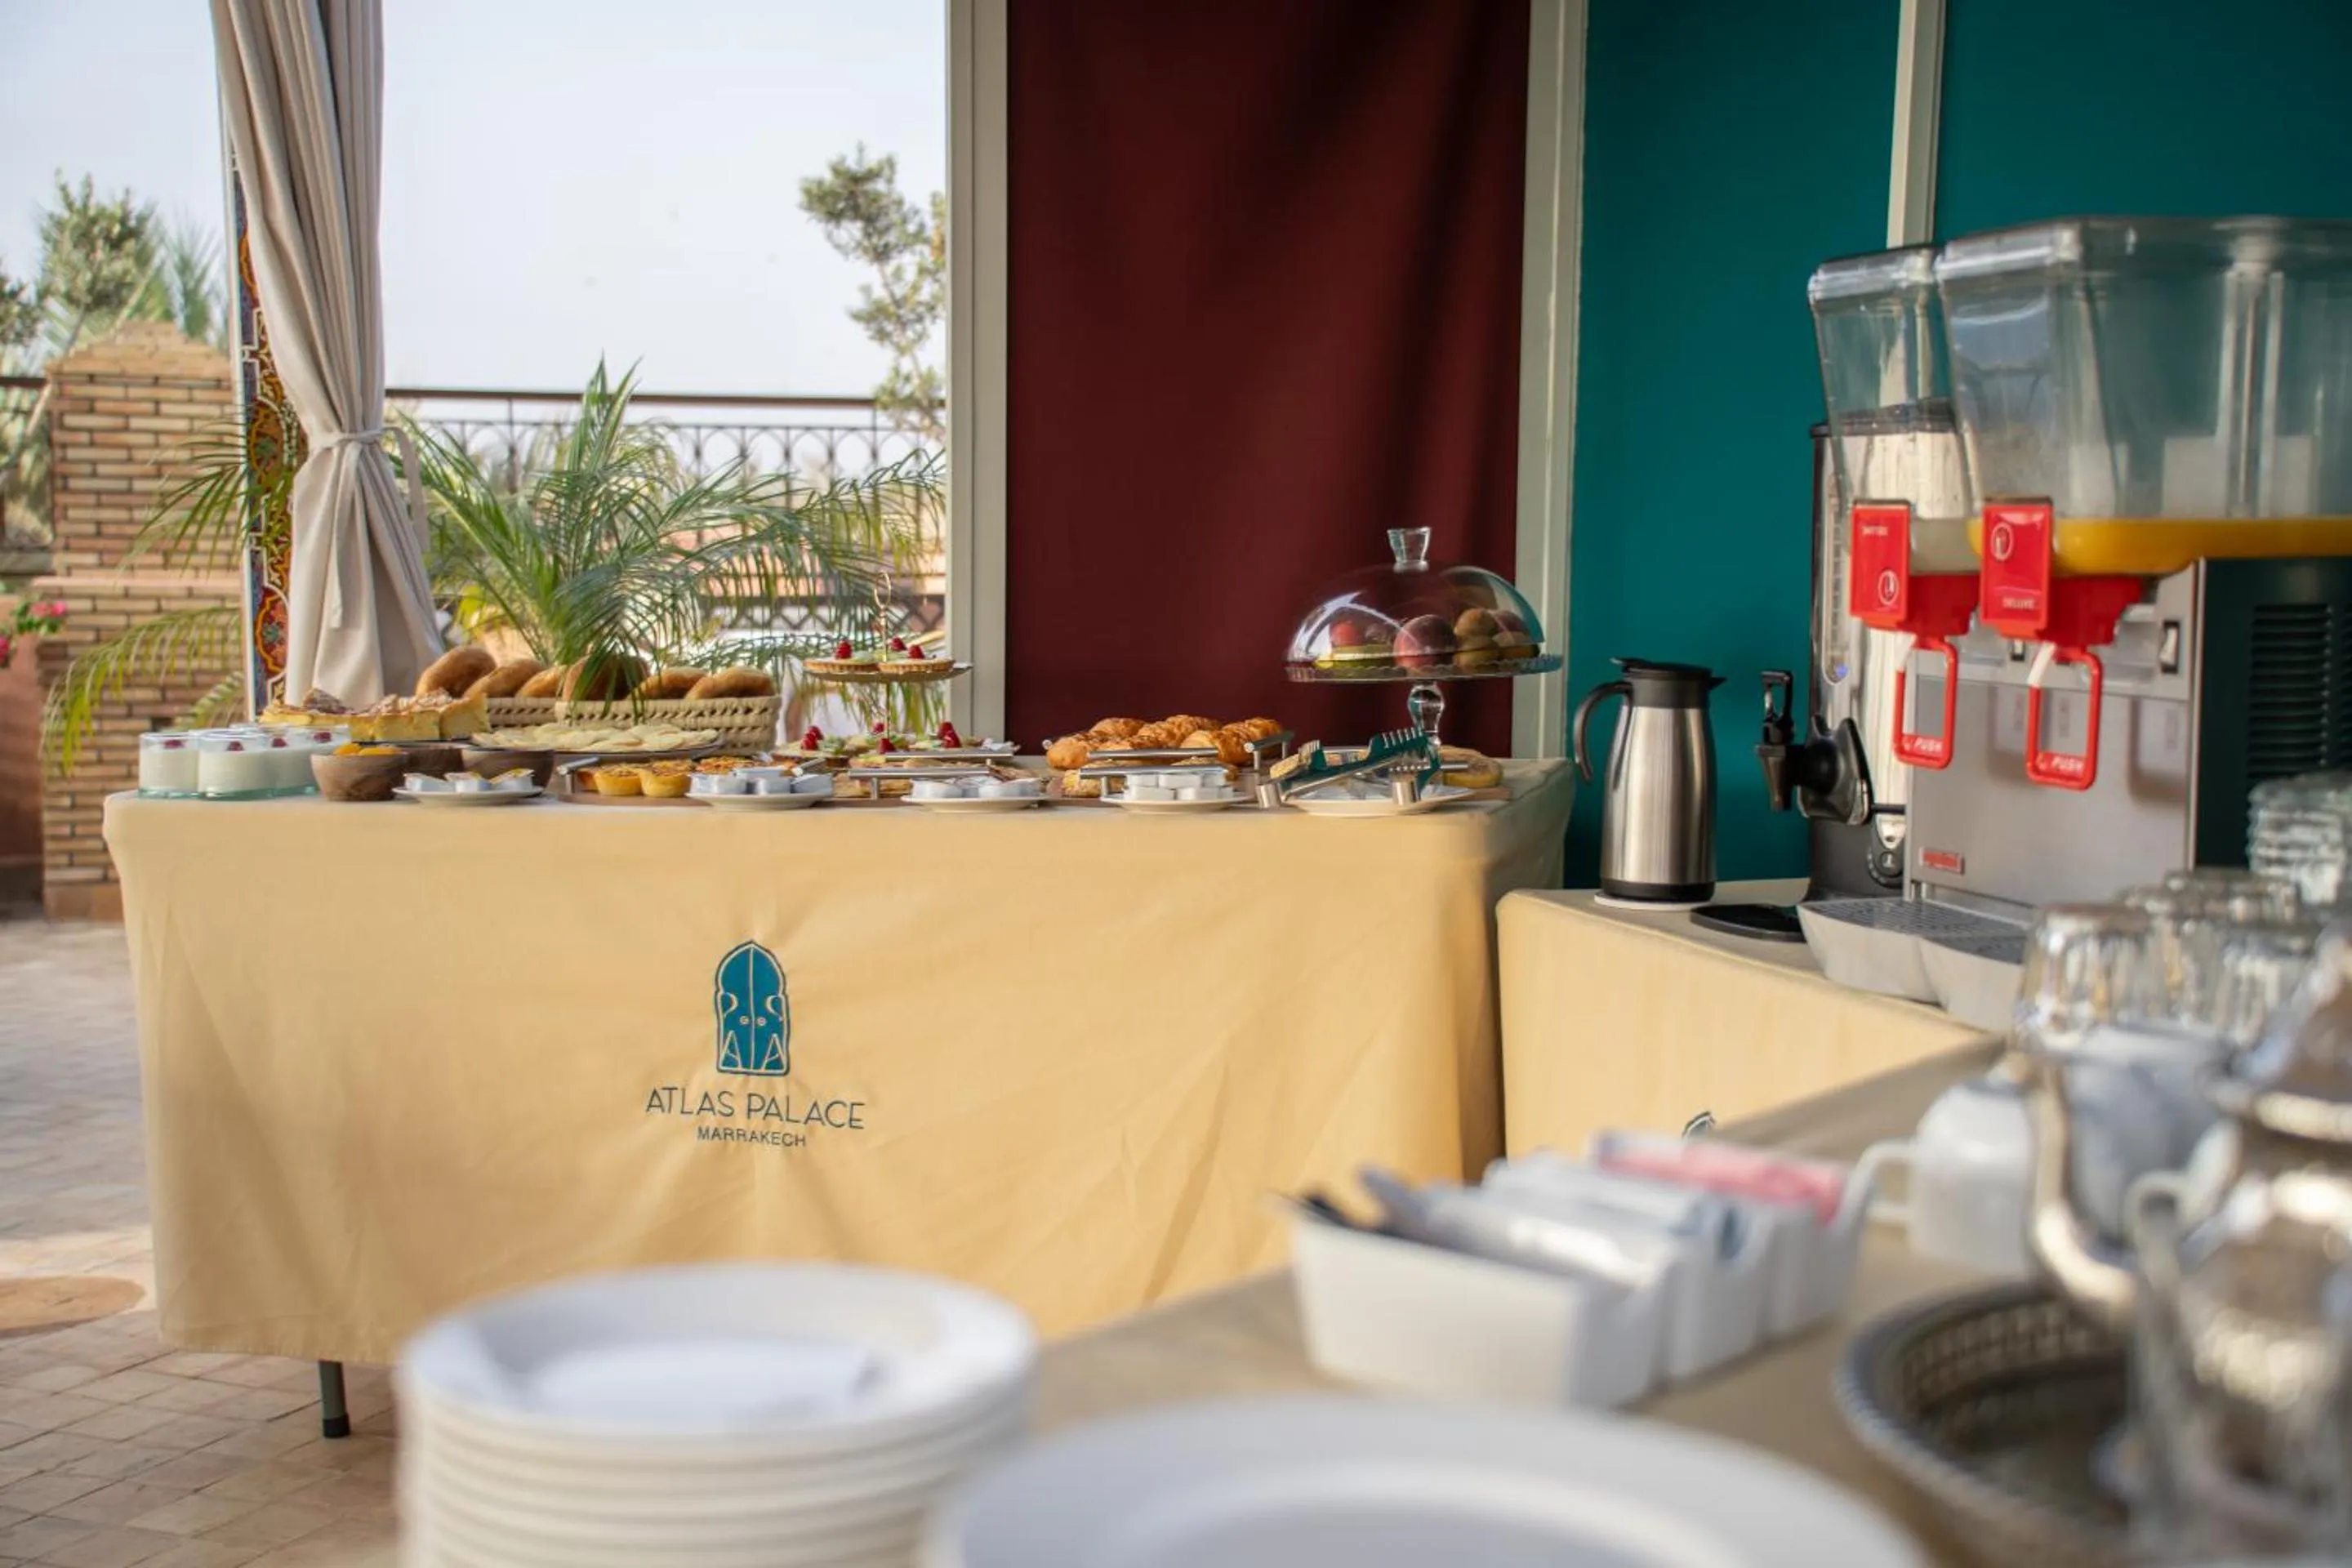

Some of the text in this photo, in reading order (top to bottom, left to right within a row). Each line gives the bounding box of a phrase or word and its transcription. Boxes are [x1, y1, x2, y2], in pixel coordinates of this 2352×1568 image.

[1913, 737, 1942, 752] PUSH
[2051, 756, 2083, 772] PUSH
[646, 1087, 866, 1129] ATLAS PALACE
[697, 1126, 806, 1147] MARRAKECH
